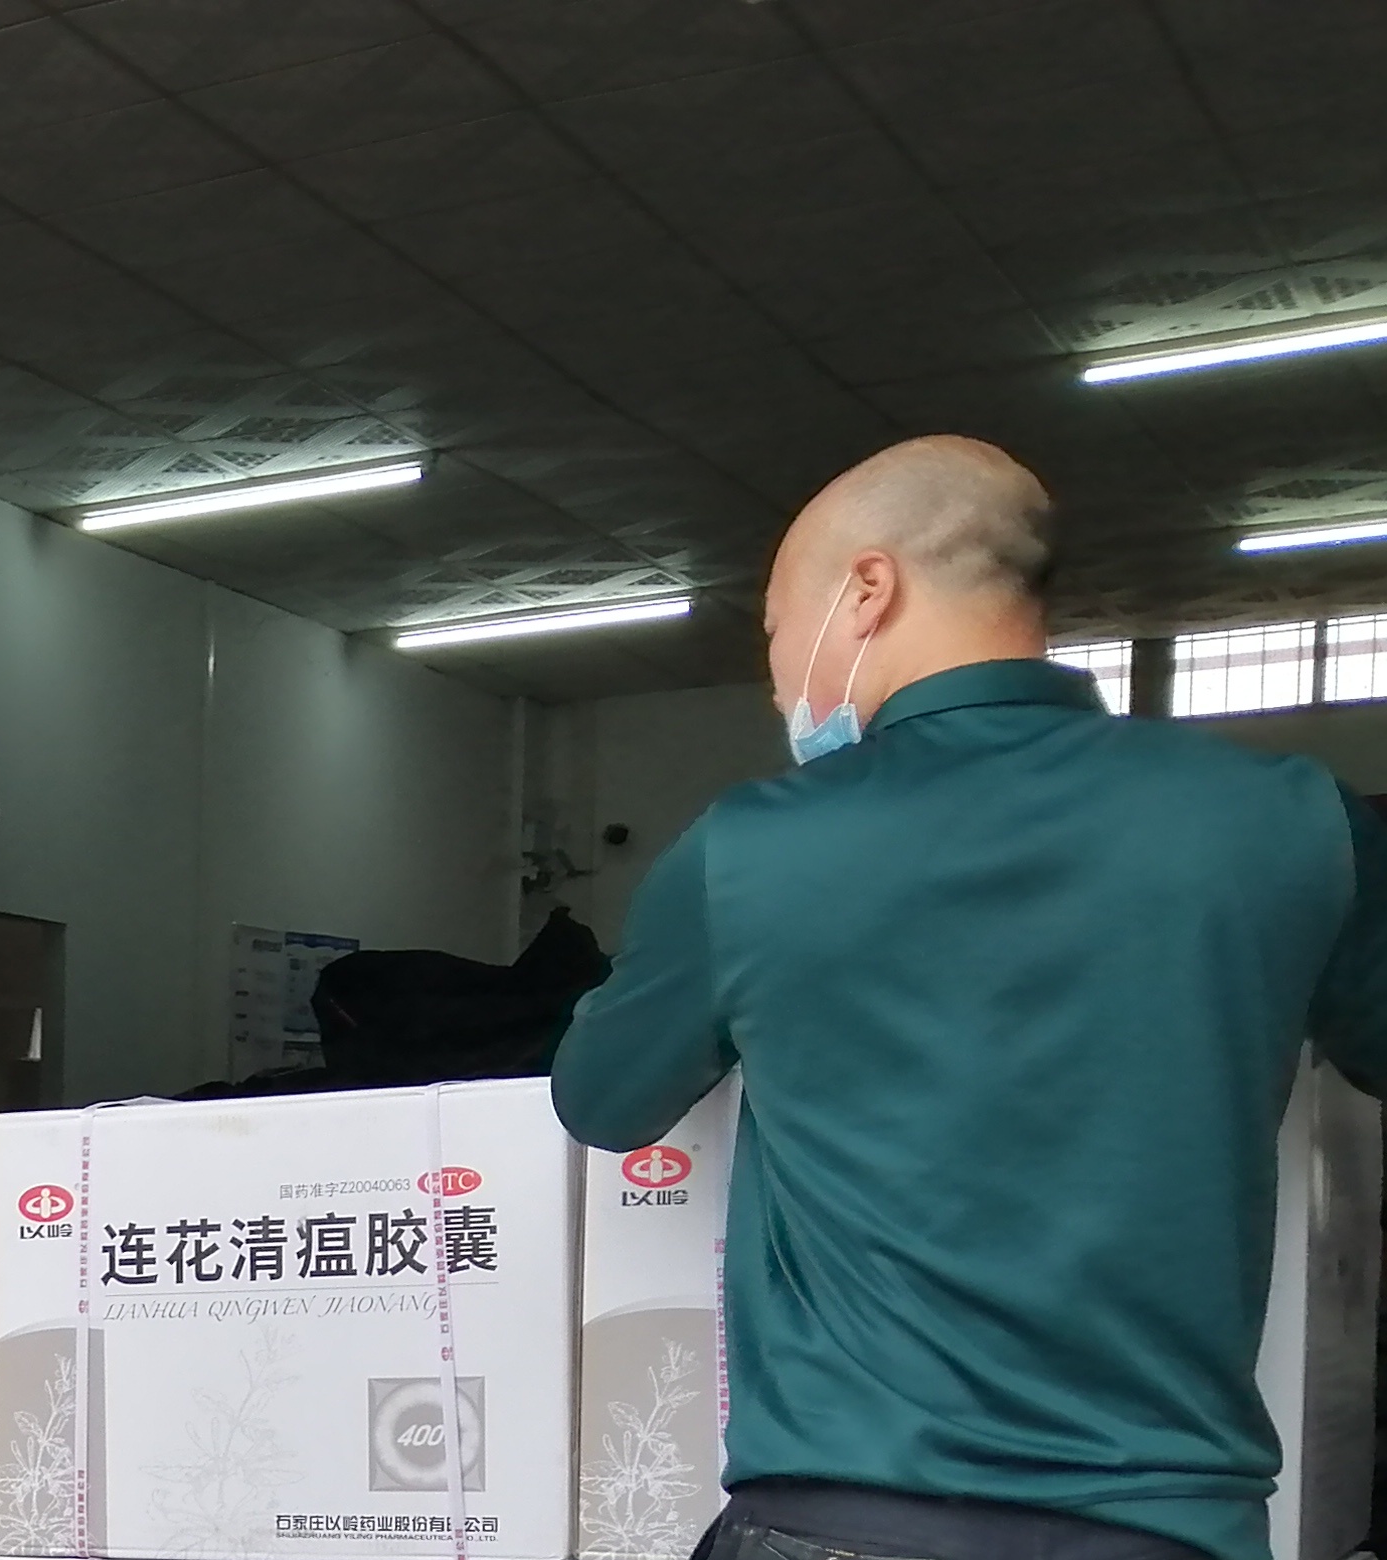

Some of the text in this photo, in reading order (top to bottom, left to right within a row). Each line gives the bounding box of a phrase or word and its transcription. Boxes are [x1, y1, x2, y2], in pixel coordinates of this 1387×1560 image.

[278, 1177, 411, 1200] 国药准字Z20040063
[621, 1190, 688, 1207] 以岭
[18, 1223, 73, 1240] 以岭
[101, 1205, 498, 1285] 连花清瘟胶囊
[102, 1292, 441, 1324] LIANHUA QINGWEN JIAONANG
[275, 1515, 498, 1532] 石家庄以岭药业股份有公司
[374, 1533, 453, 1541] PHARMACEUTICA
